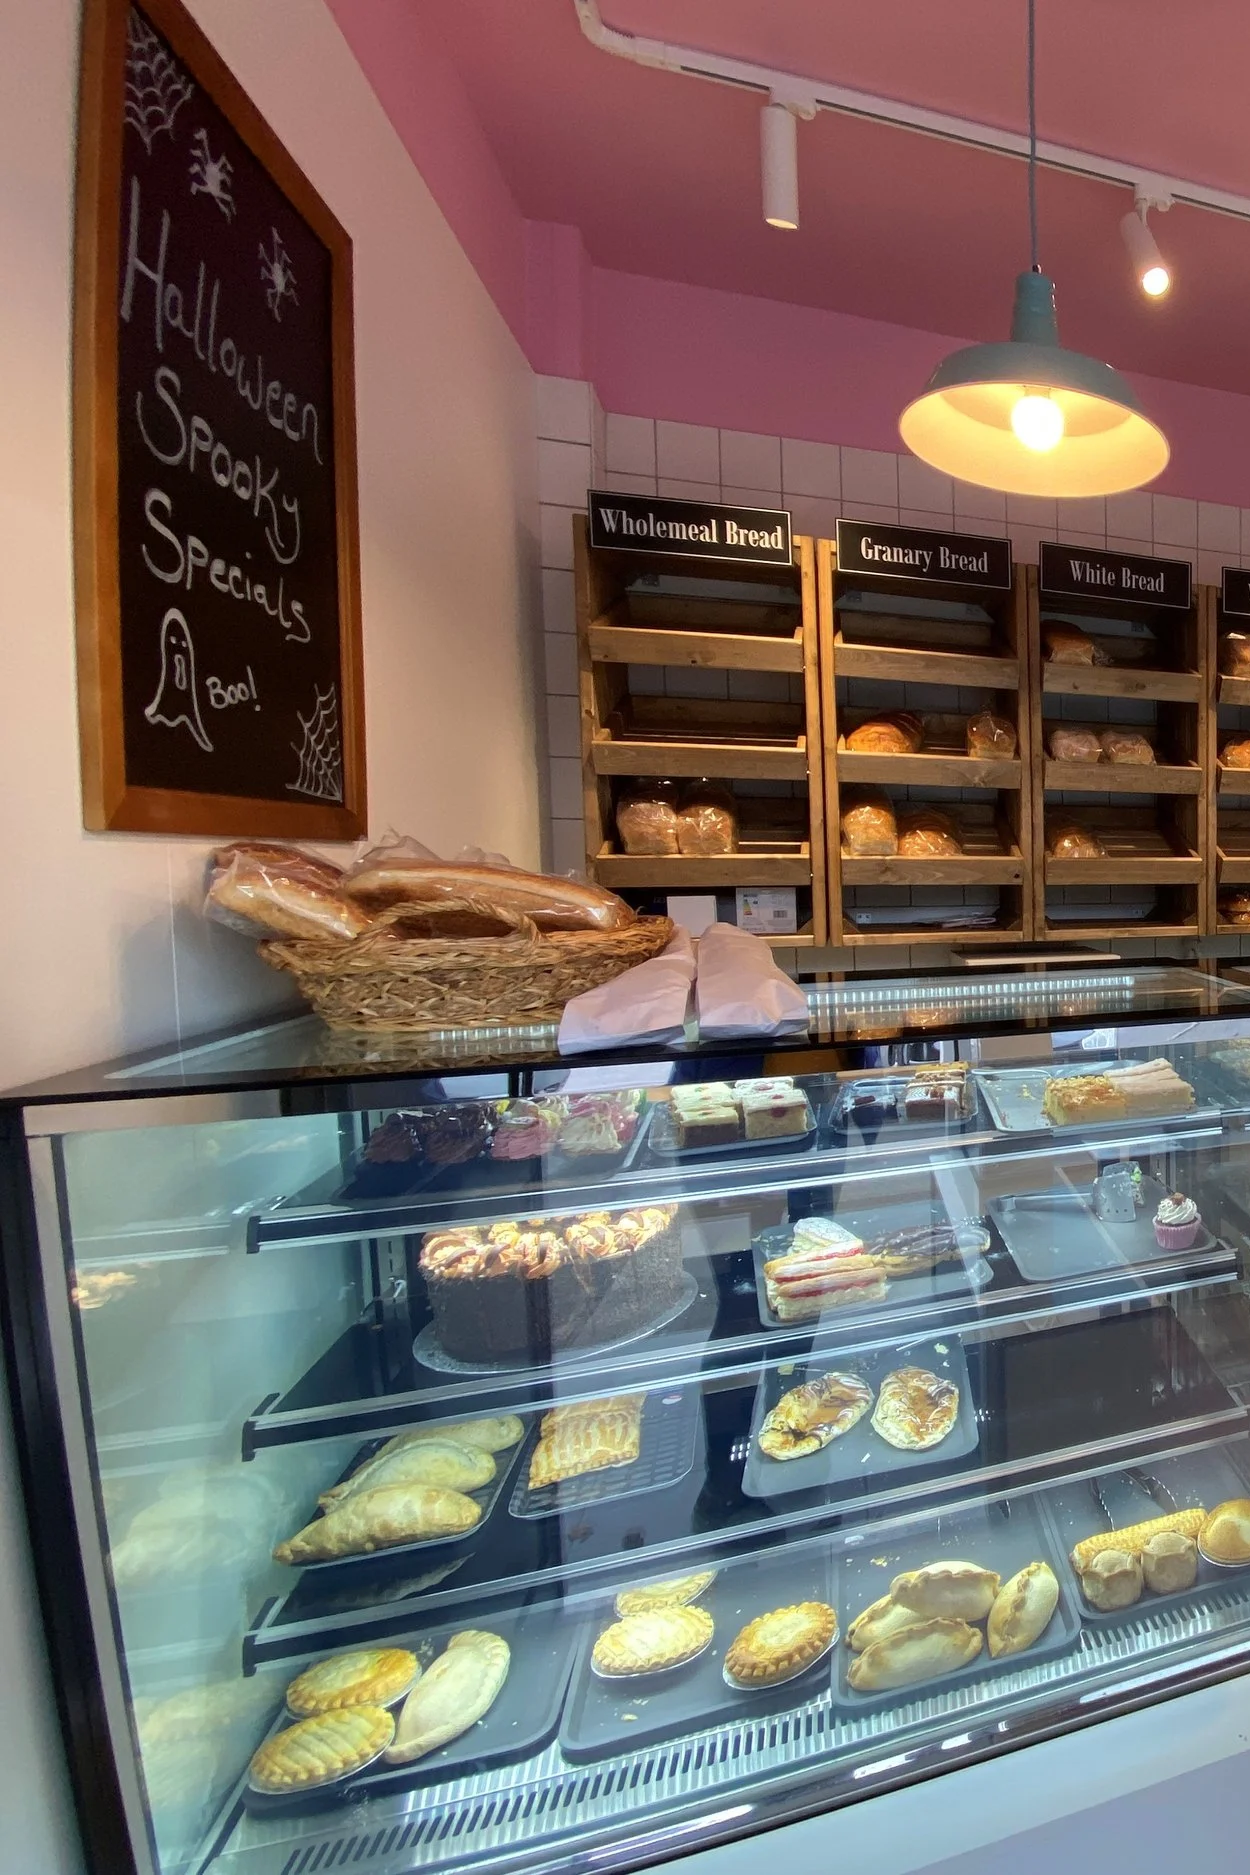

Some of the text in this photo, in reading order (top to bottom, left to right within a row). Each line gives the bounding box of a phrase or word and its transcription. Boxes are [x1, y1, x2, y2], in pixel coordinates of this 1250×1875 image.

[121, 176, 325, 466] Halloween
[598, 508, 784, 550] Wholemeal Bread
[141, 488, 312, 643] Specials
[860, 536, 989, 573] Granary Bread
[1069, 559, 1165, 593] White Bread
[206, 667, 261, 712] Boo!
